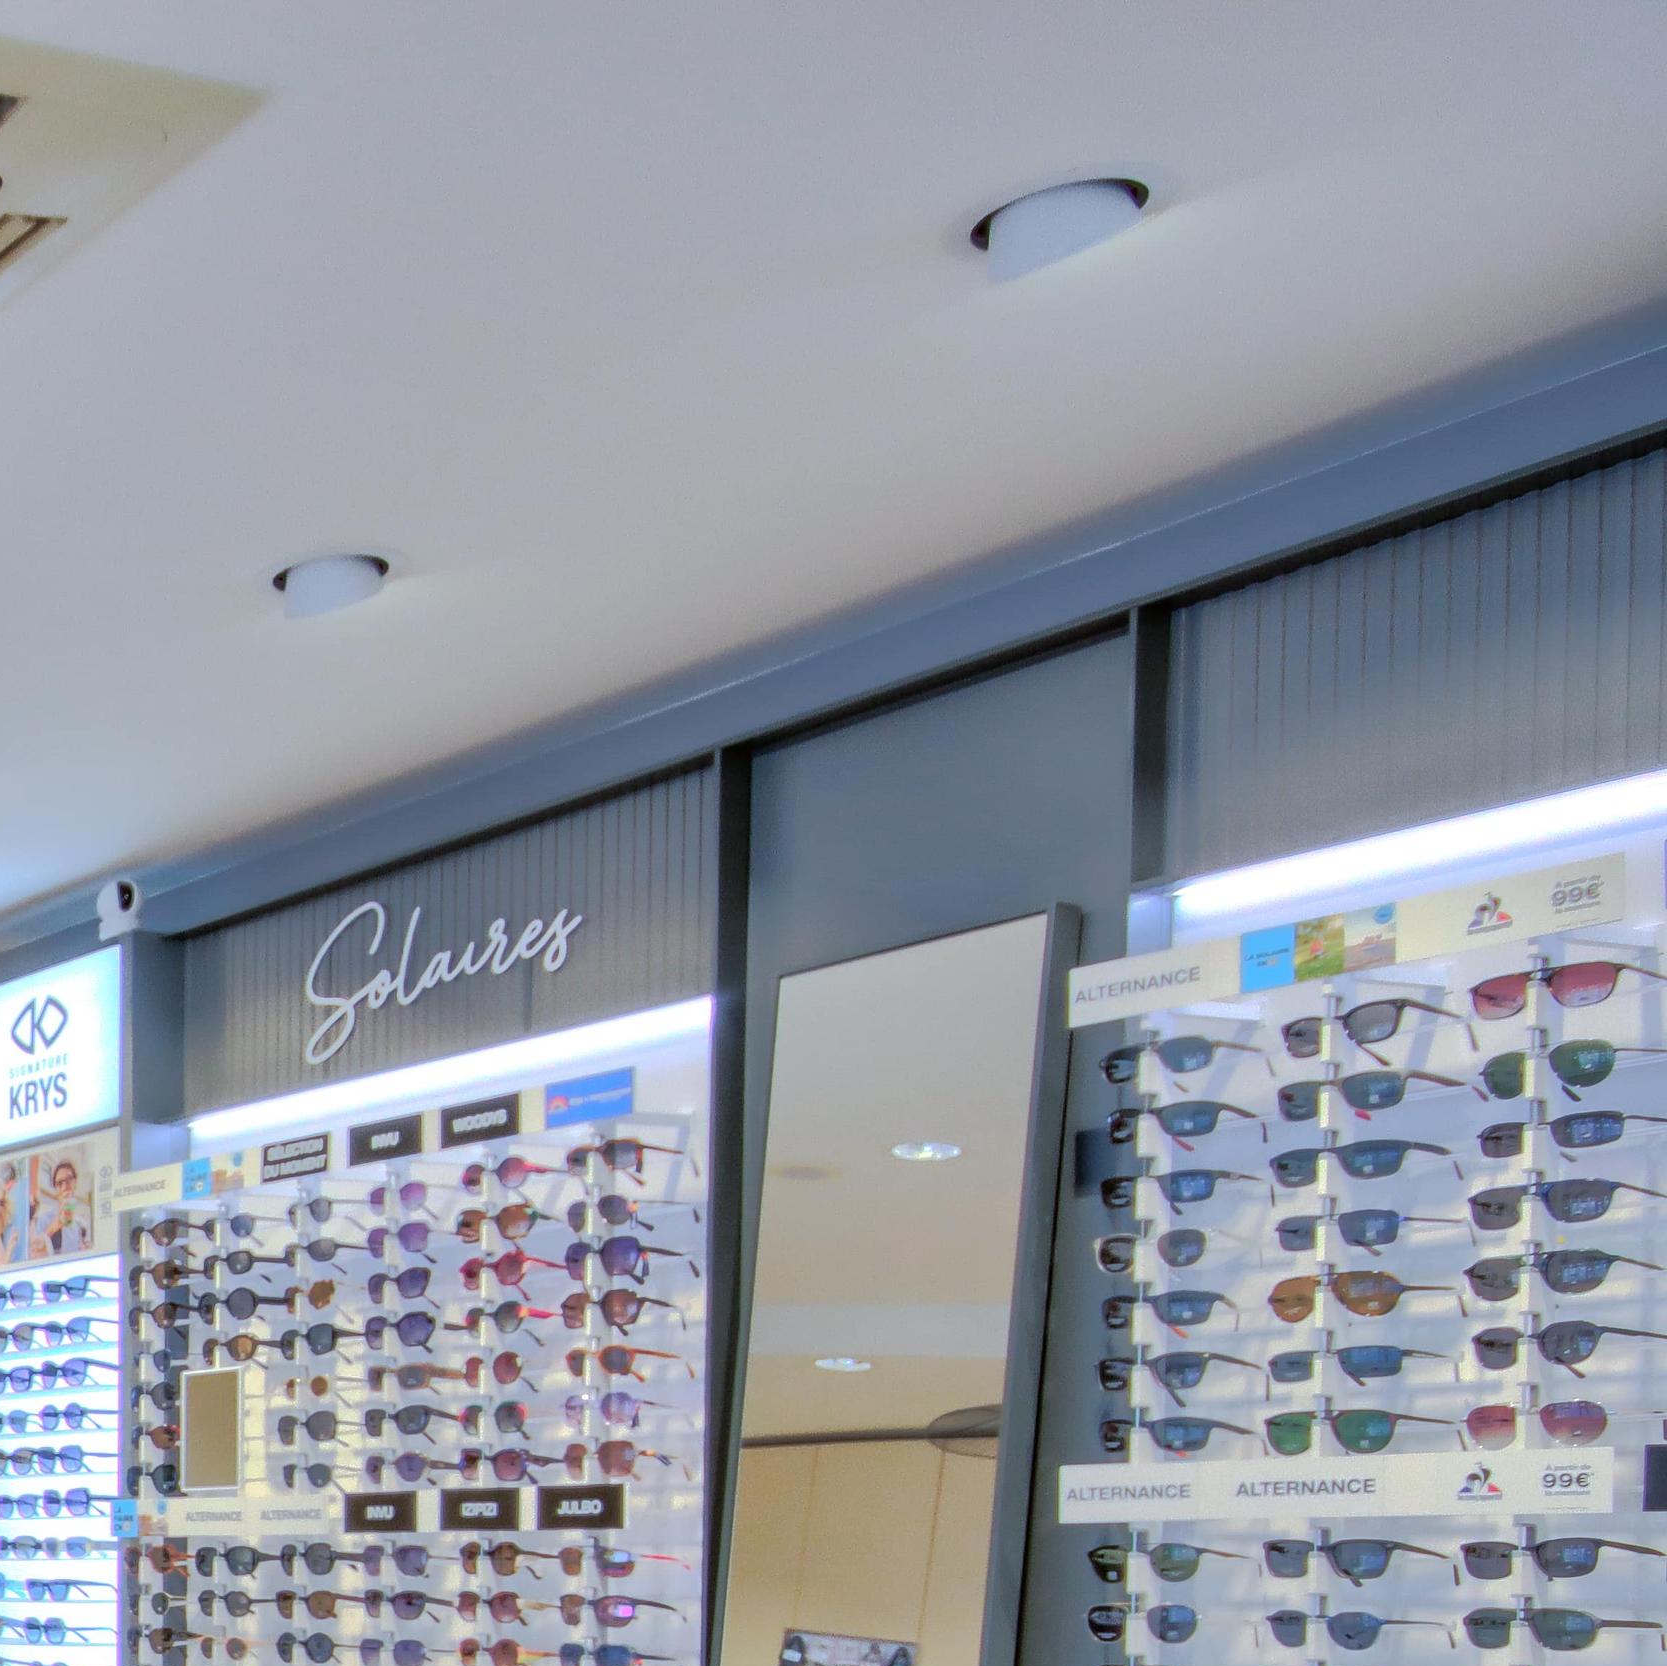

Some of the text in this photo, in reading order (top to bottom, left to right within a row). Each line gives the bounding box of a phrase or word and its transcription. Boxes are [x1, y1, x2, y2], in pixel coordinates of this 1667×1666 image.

[305, 901, 584, 1065] Solaires
[1074, 966, 1201, 1003] ALTERNANCE
[9, 1053, 68, 1080] SIGNATURE
[9, 1072, 68, 1120] KRYS
[113, 1179, 166, 1198] ALTERNANCE
[1067, 1483, 1191, 1501] ALTERNANCE
[1236, 1478, 1377, 1498] ALTERNANCE
[185, 1511, 243, 1524] ALTERNANCE
[260, 1508, 322, 1522] ALTERNANCE
[557, 1500, 604, 1517] JULBO
